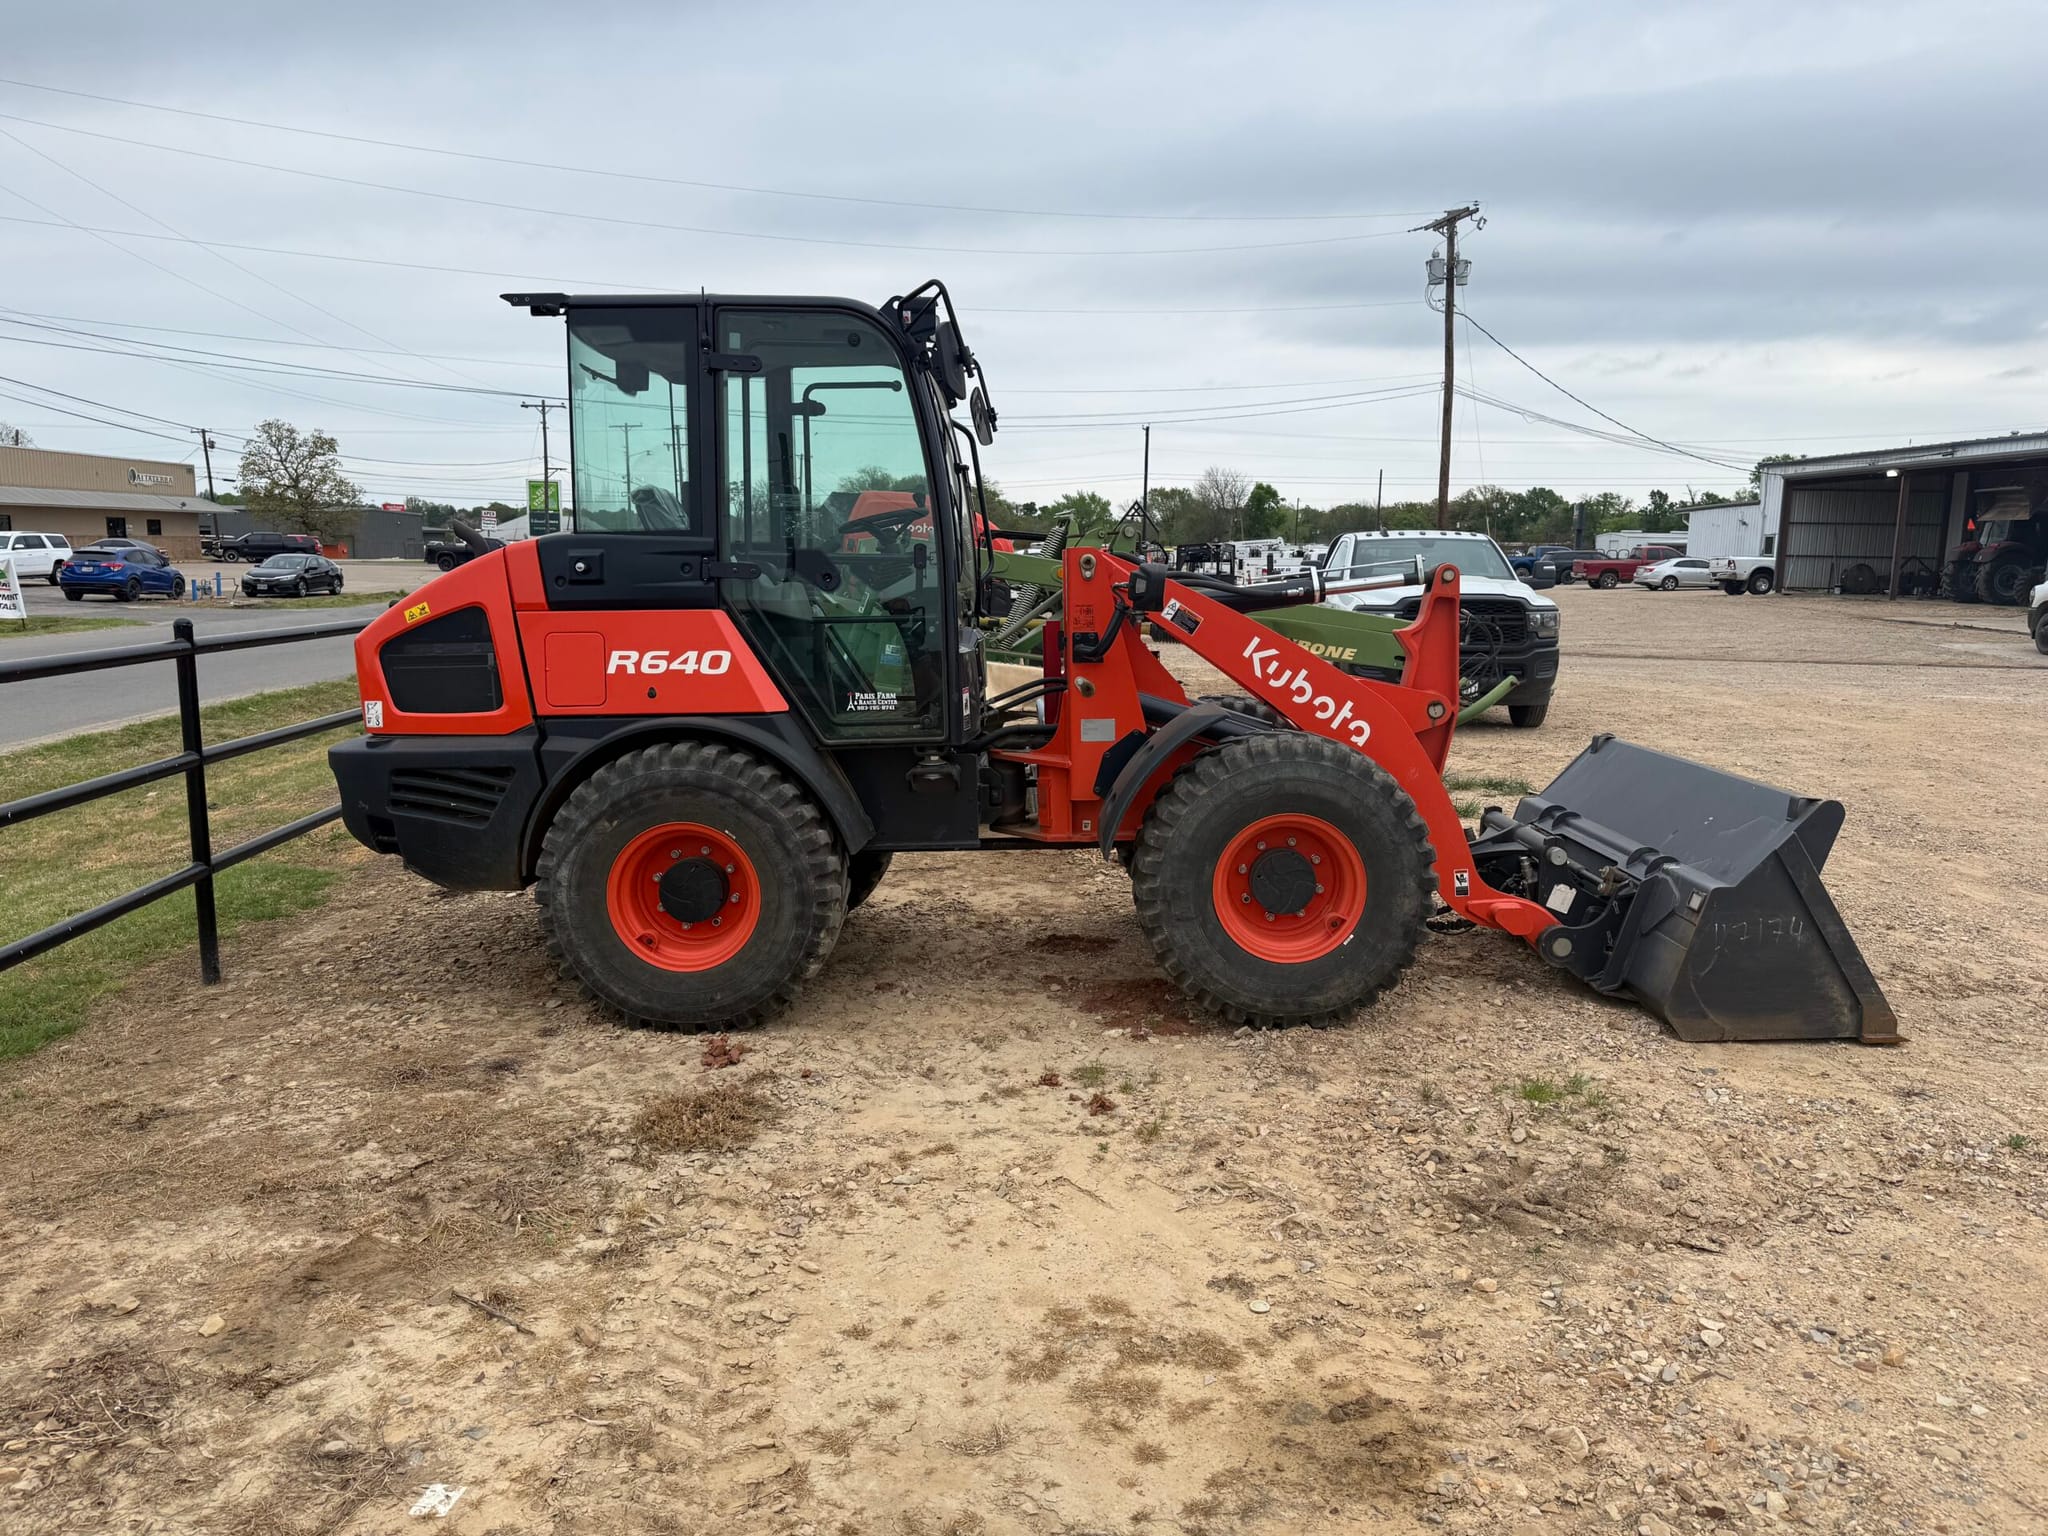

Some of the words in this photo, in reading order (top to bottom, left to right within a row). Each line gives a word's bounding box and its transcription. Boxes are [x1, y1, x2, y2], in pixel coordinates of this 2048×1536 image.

[1294, 639, 1358, 660] RONE
[606, 649, 732, 675] R640
[855, 692, 876, 700] PARIS
[877, 691, 896, 700] FARM
[1242, 636, 1371, 747] Kubota
